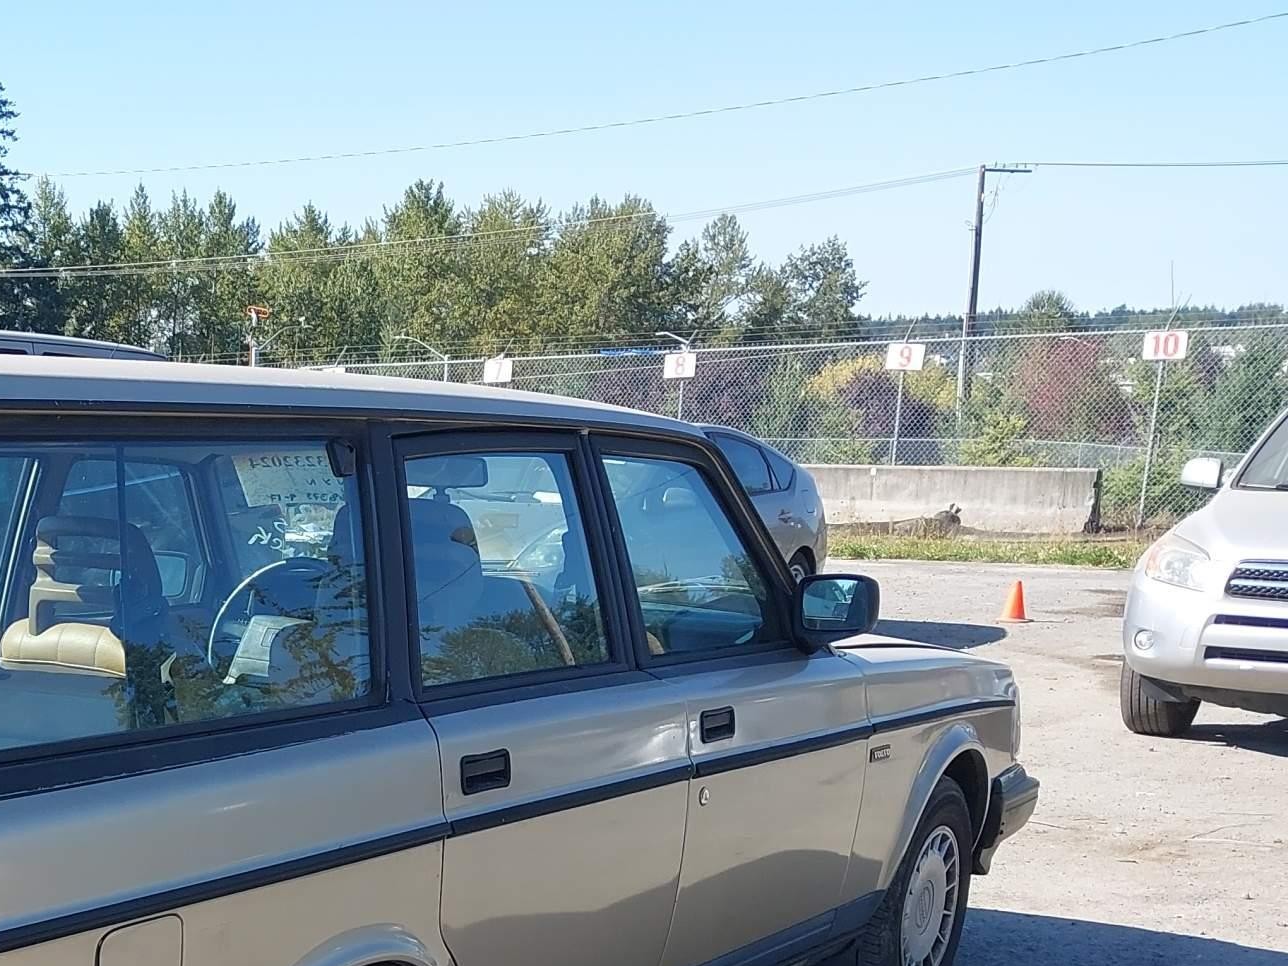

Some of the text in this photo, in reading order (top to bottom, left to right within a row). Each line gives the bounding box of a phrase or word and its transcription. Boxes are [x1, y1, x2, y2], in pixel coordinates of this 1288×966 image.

[1152, 333, 1179, 357] 10
[675, 356, 685, 375] 8
[899, 345, 912, 367] 9
[495, 361, 503, 380] 7
